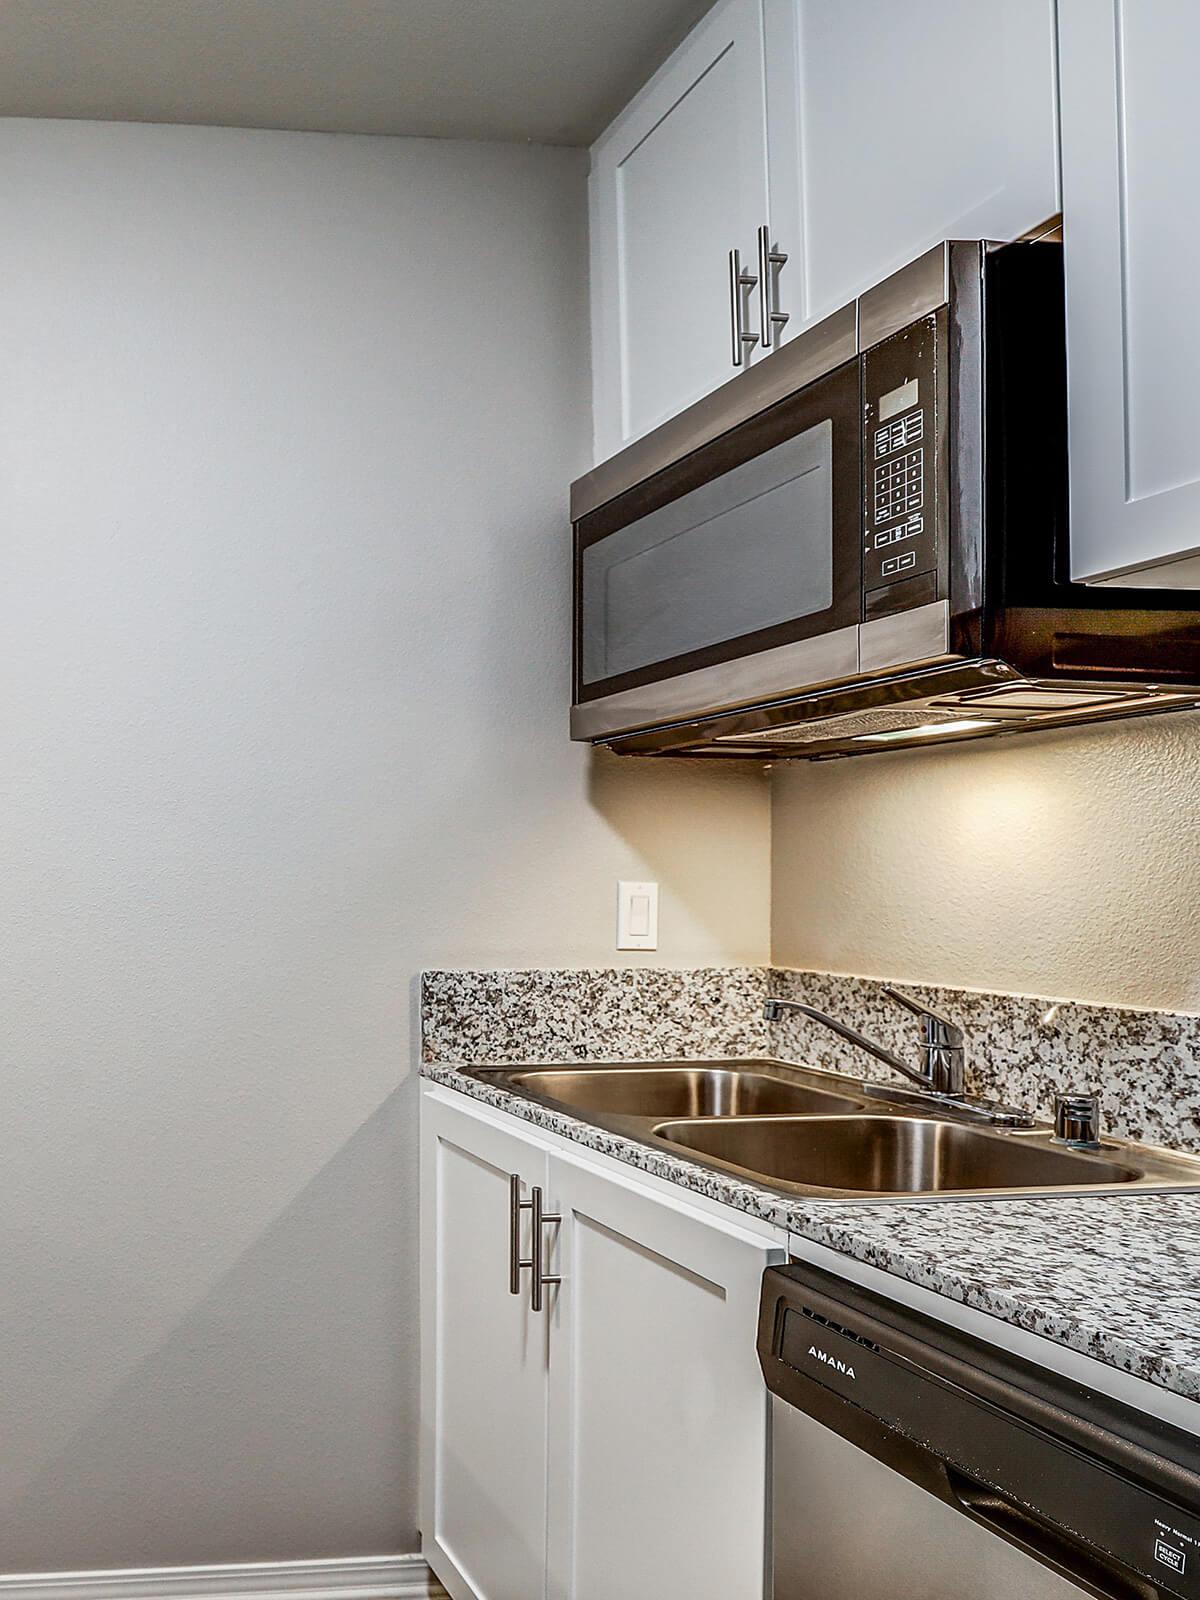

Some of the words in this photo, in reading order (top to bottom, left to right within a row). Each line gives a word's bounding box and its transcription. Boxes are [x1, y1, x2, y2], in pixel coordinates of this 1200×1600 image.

[808, 1346, 856, 1379] AMANA
[1154, 1518, 1172, 1532] Heavy
[1172, 1528, 1193, 1543] Normal
[1158, 1545, 1181, 1561] SELECT
[1159, 1553, 1179, 1568] CYCLE
